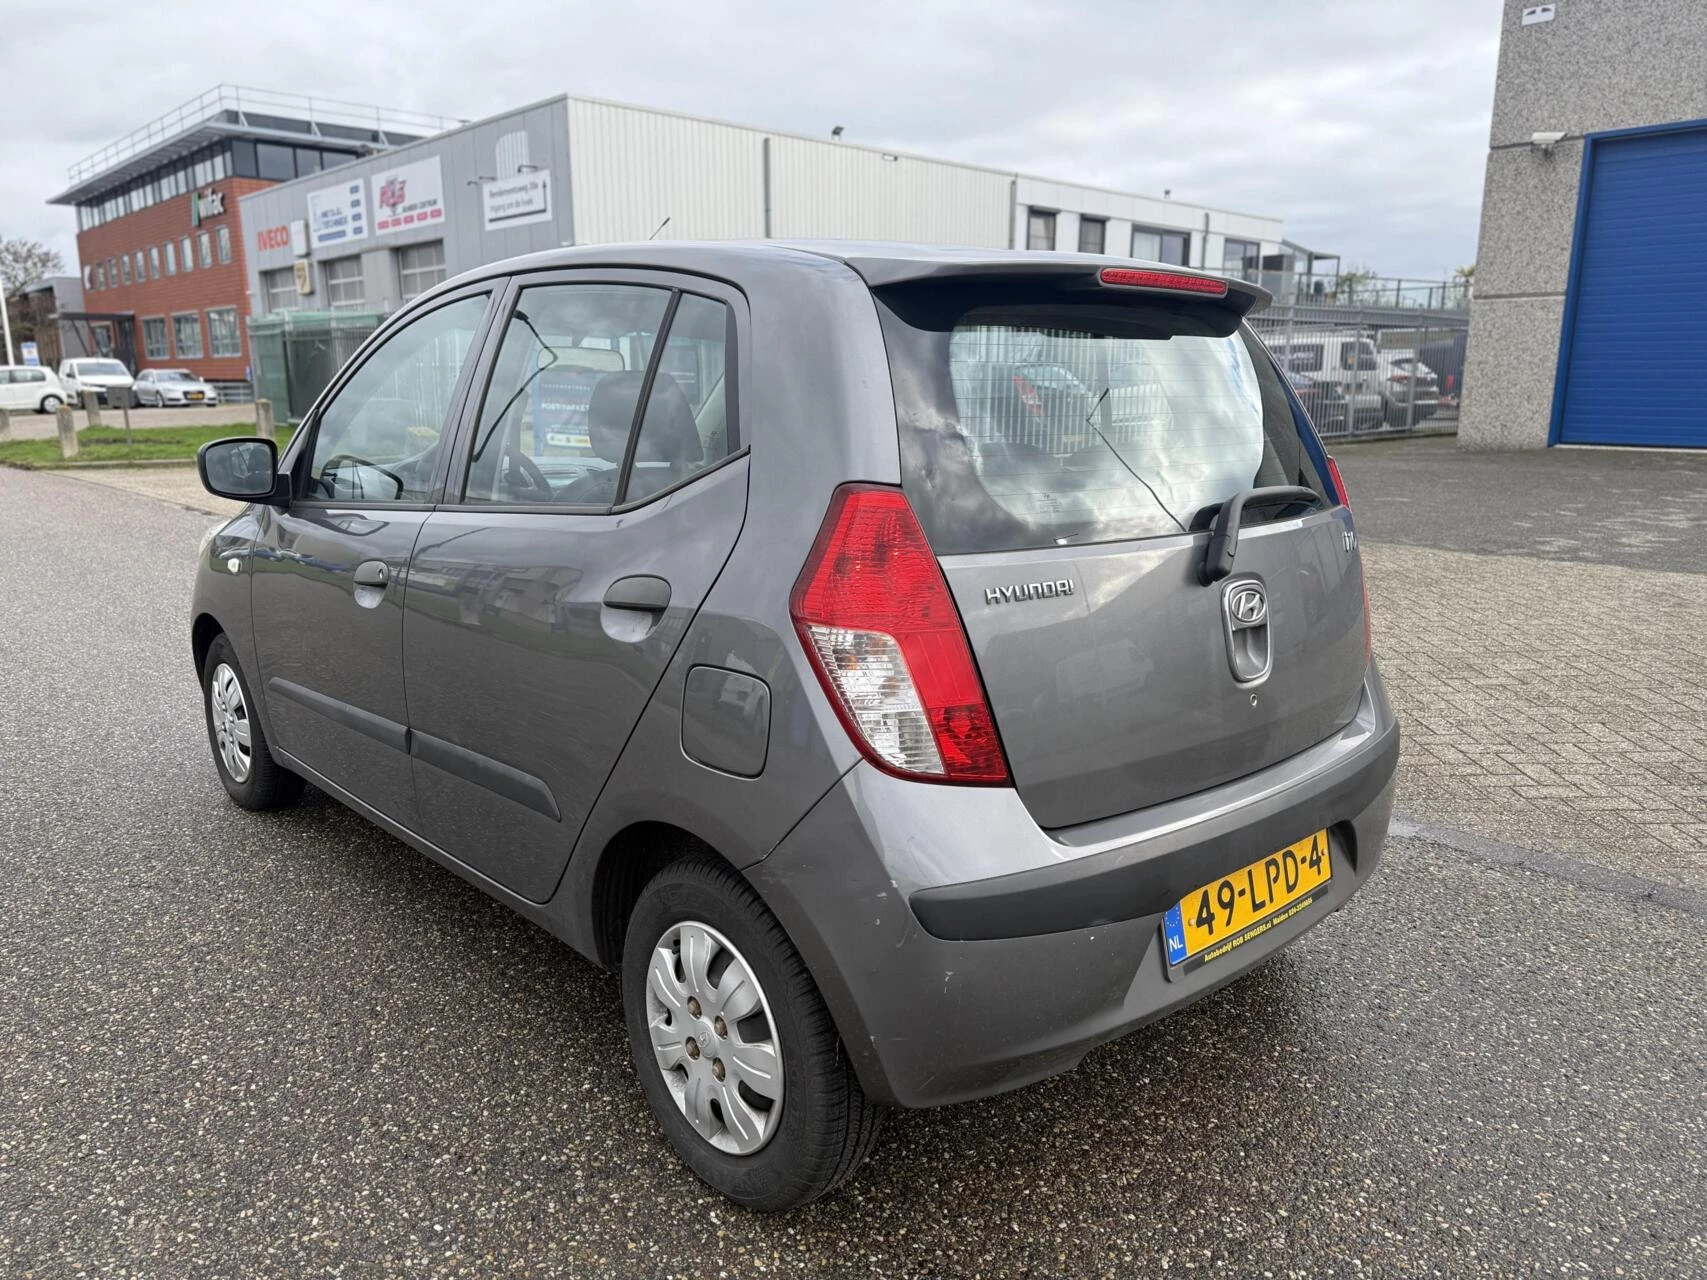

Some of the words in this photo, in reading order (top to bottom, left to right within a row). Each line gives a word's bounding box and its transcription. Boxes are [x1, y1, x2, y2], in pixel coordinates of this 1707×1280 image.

[257, 225, 289, 251] IVECO
[984, 579, 1074, 605] HYUNDAI
[1196, 835, 1322, 935] 49-LPD-4
[1168, 935, 1184, 952] NL
